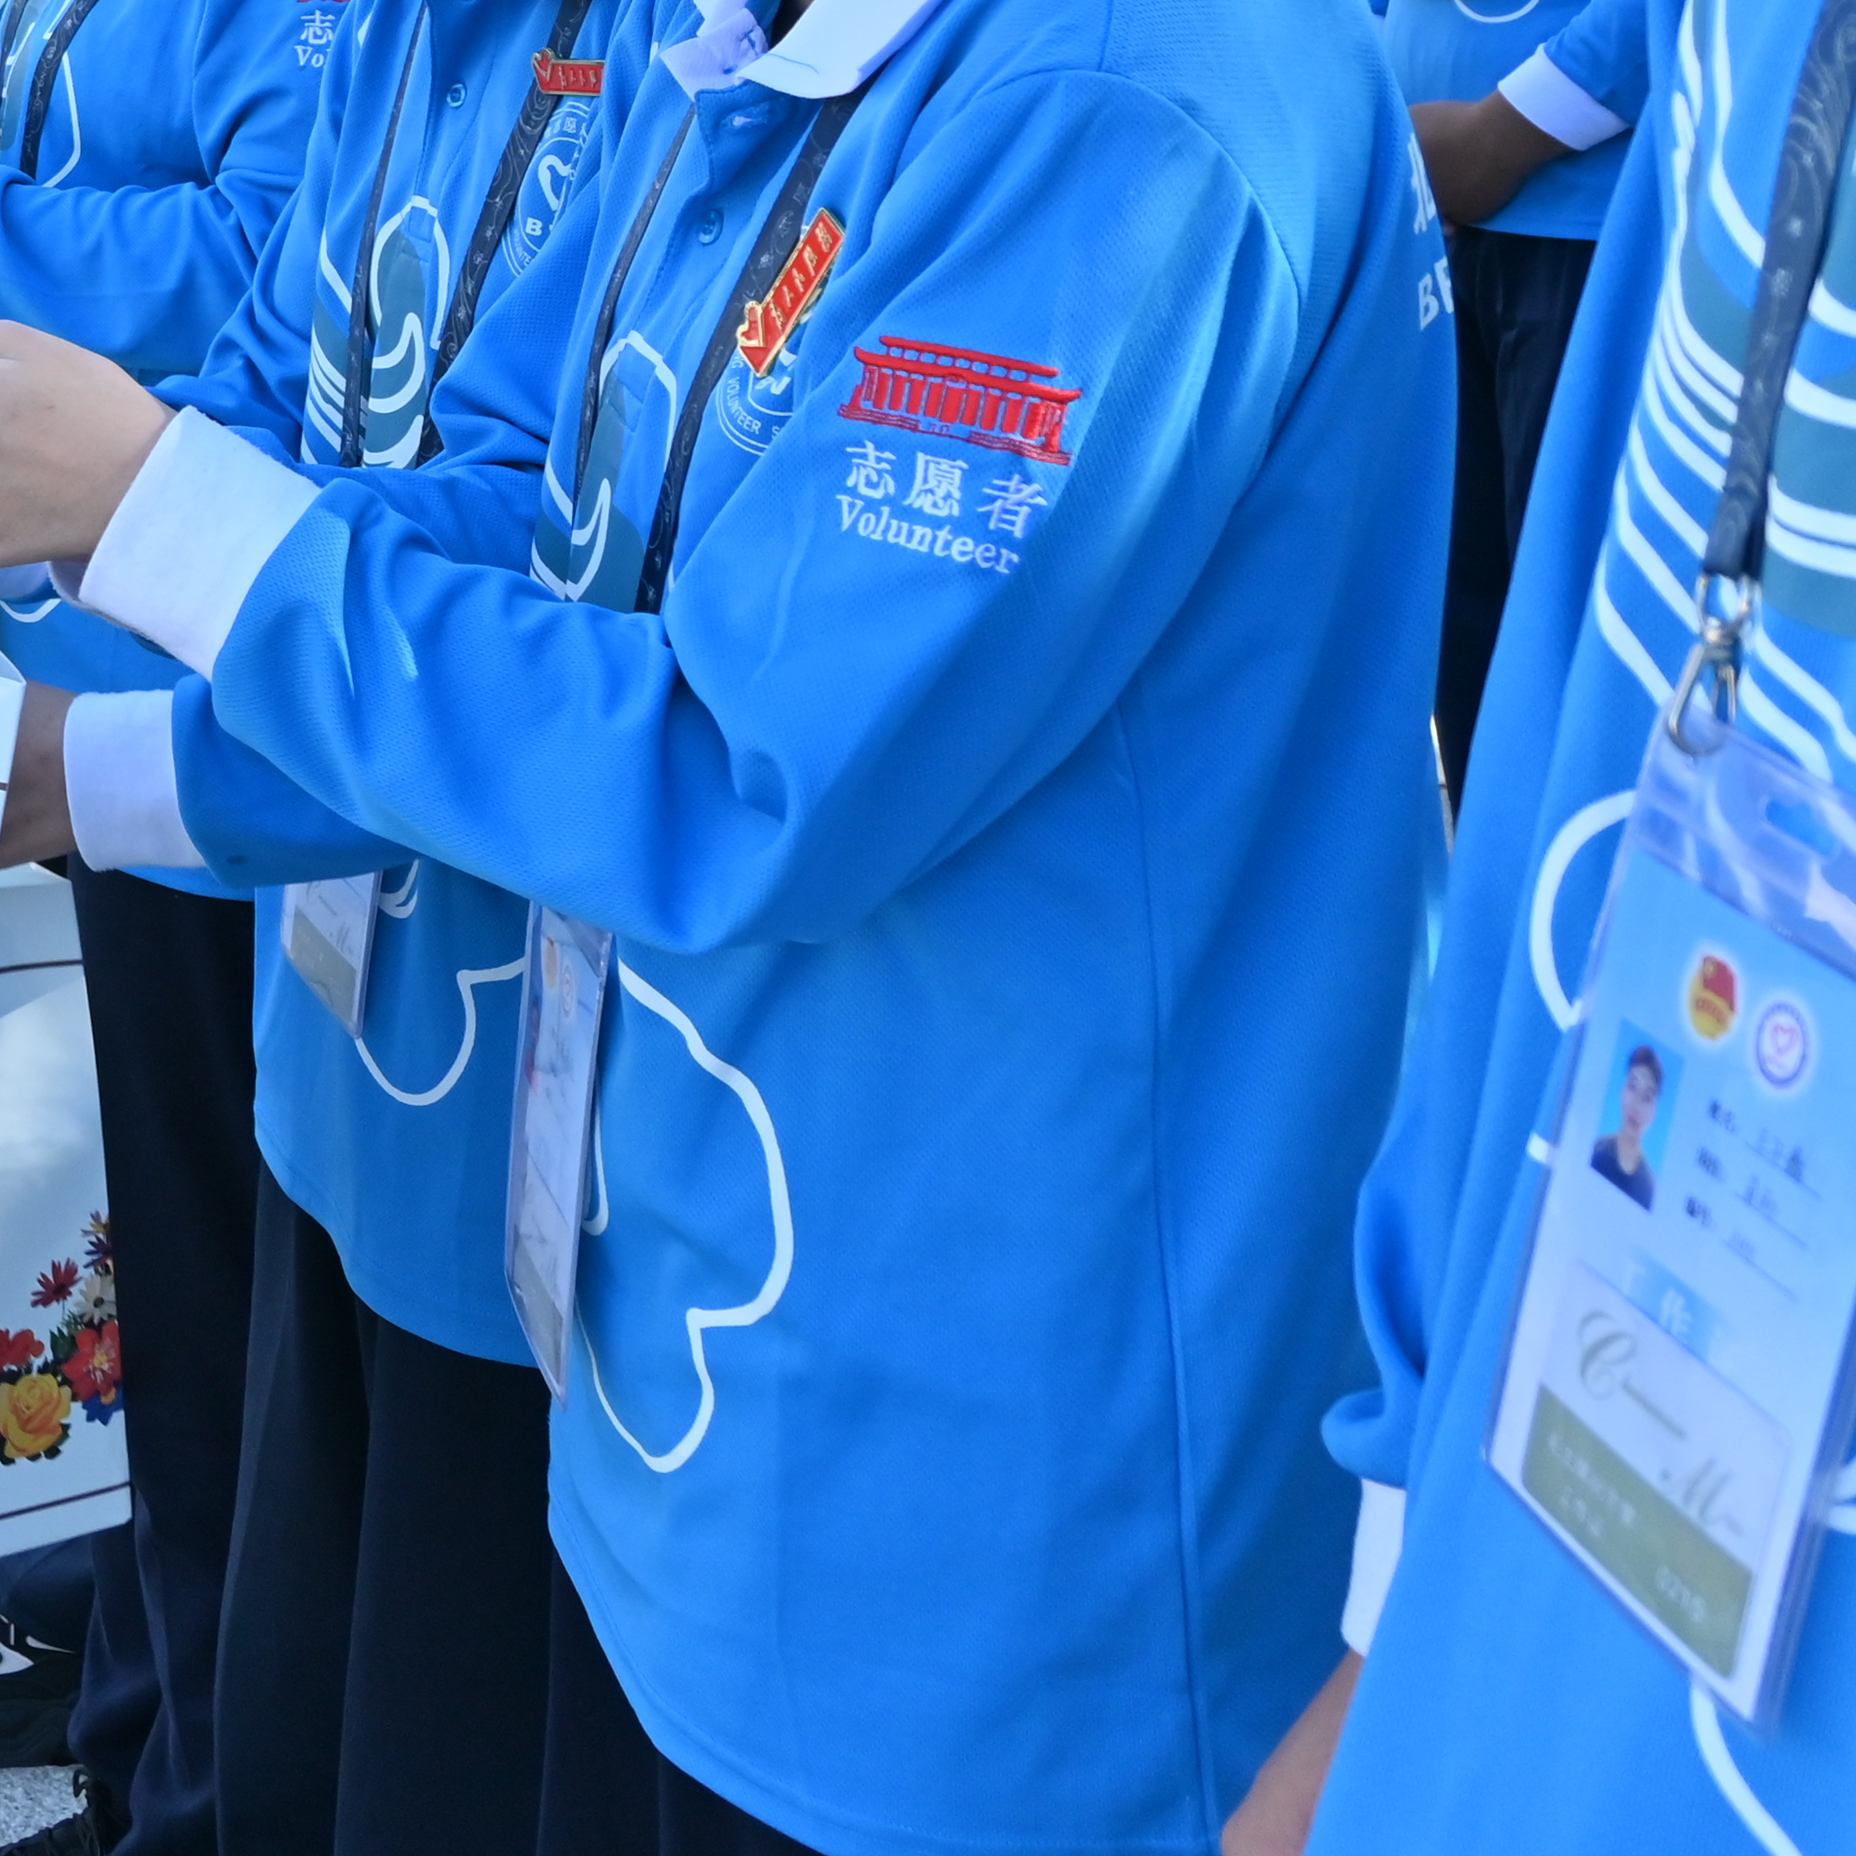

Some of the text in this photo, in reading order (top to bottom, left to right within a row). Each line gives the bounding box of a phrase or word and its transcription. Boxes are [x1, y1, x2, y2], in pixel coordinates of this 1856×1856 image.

[294, 45, 331, 68] Vo
[727, 377, 762, 435] VOLUNTEER
[845, 439, 1048, 539] 志愿者
[835, 494, 1020, 574] Volunteer
